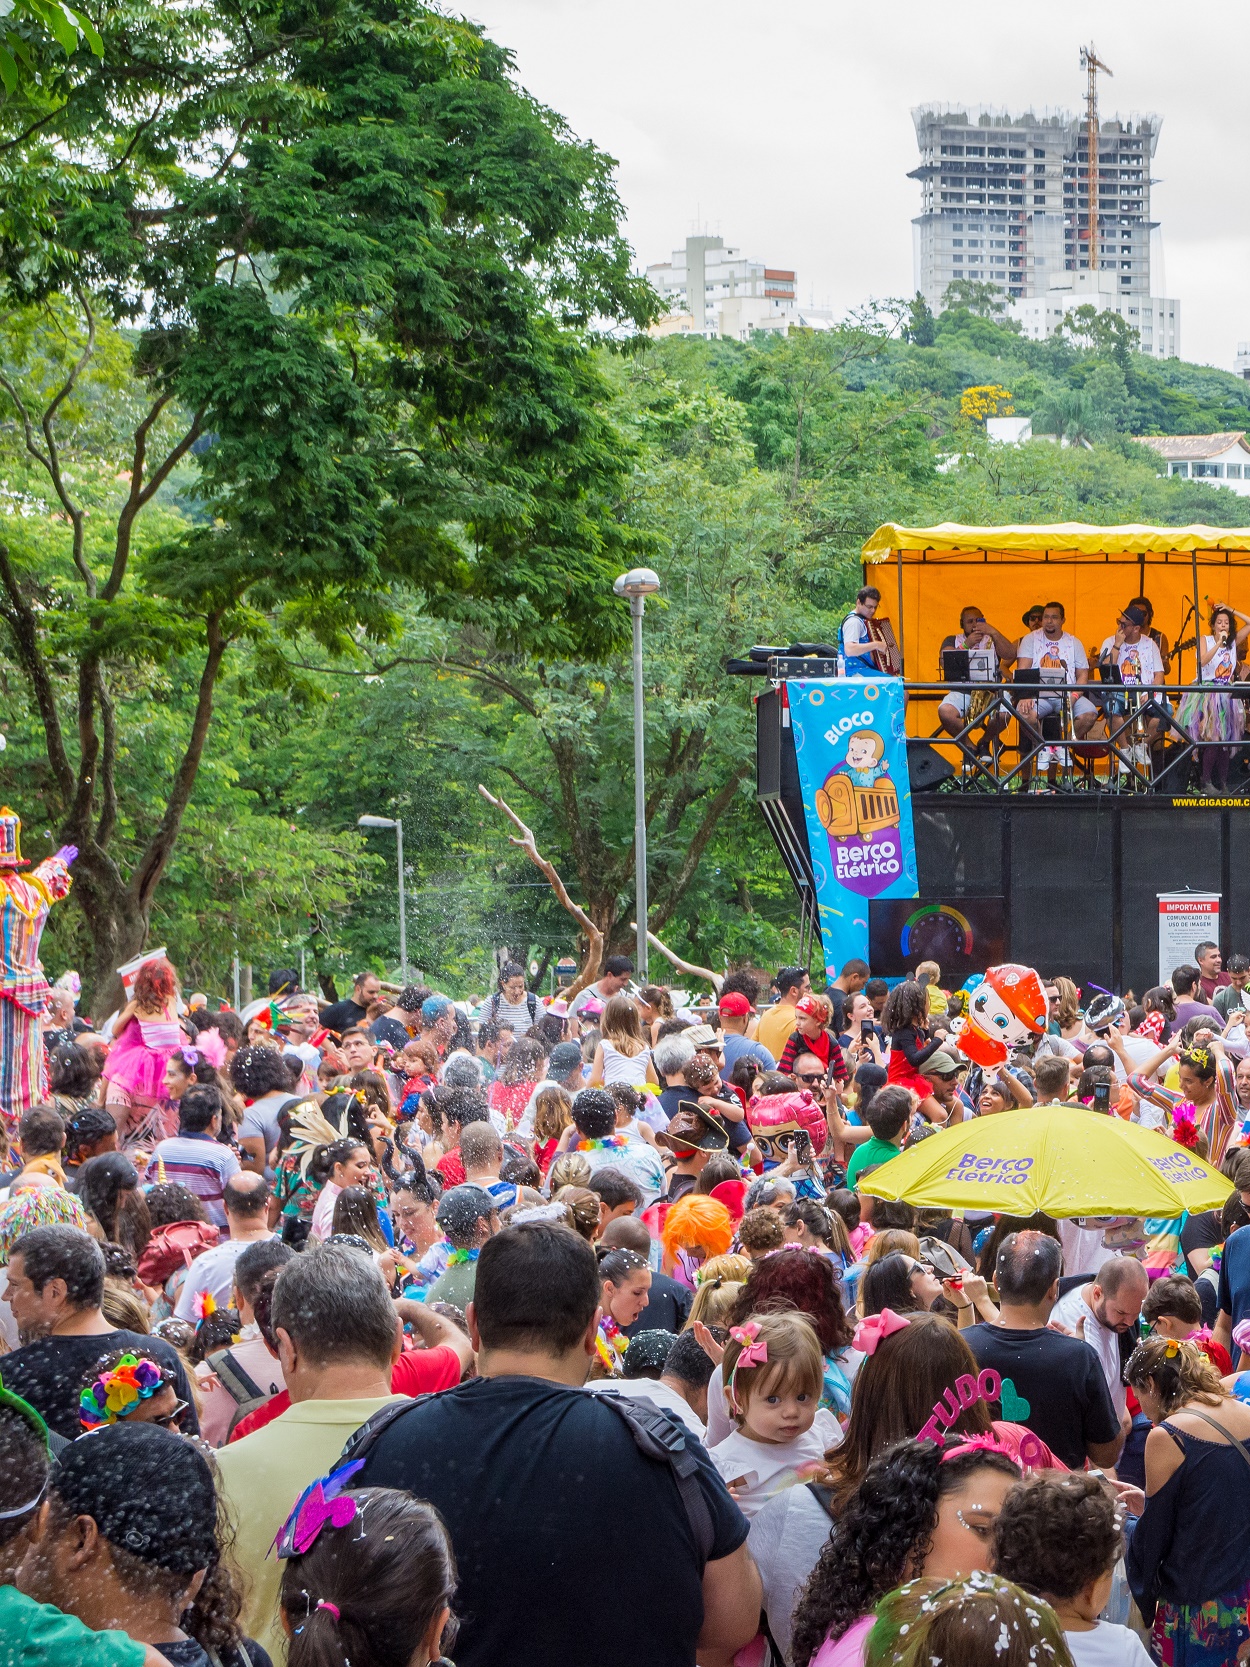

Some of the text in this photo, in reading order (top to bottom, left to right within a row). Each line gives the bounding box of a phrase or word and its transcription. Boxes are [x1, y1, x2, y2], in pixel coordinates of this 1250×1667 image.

[824, 711, 874, 746] BLOCO
[836, 841, 896, 864] Berço
[835, 858, 900, 879] Elétrico
[1166, 903, 1212, 911] IMPORTANTE
[957, 1153, 1034, 1174] Berço
[945, 1167, 1029, 1185] Elétrico
[915, 1368, 1002, 1448] TUDO
